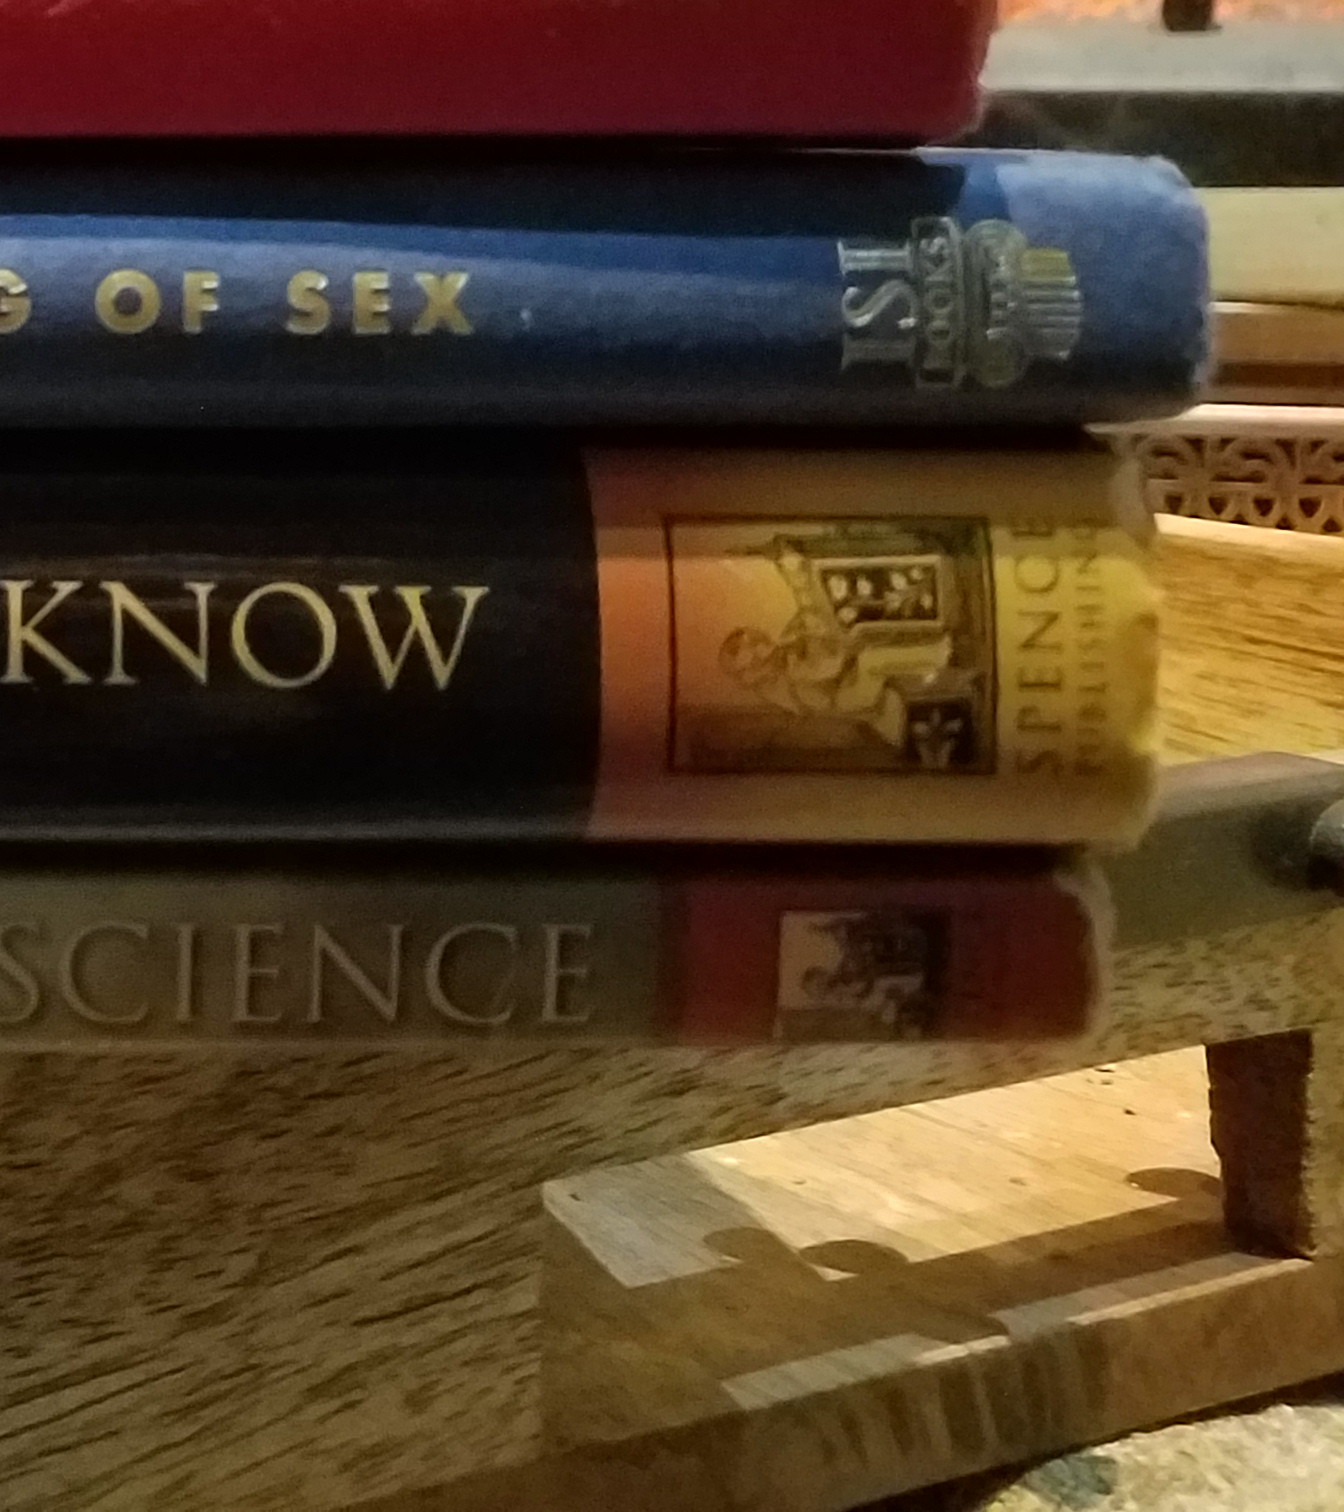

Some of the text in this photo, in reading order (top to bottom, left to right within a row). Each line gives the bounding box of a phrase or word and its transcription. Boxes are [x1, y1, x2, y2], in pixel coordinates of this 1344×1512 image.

[94, 269, 222, 336] OF
[284, 270, 476, 336] SEX
[837, 239, 917, 371] ISI
[1013, 514, 1063, 776] SPENCE
